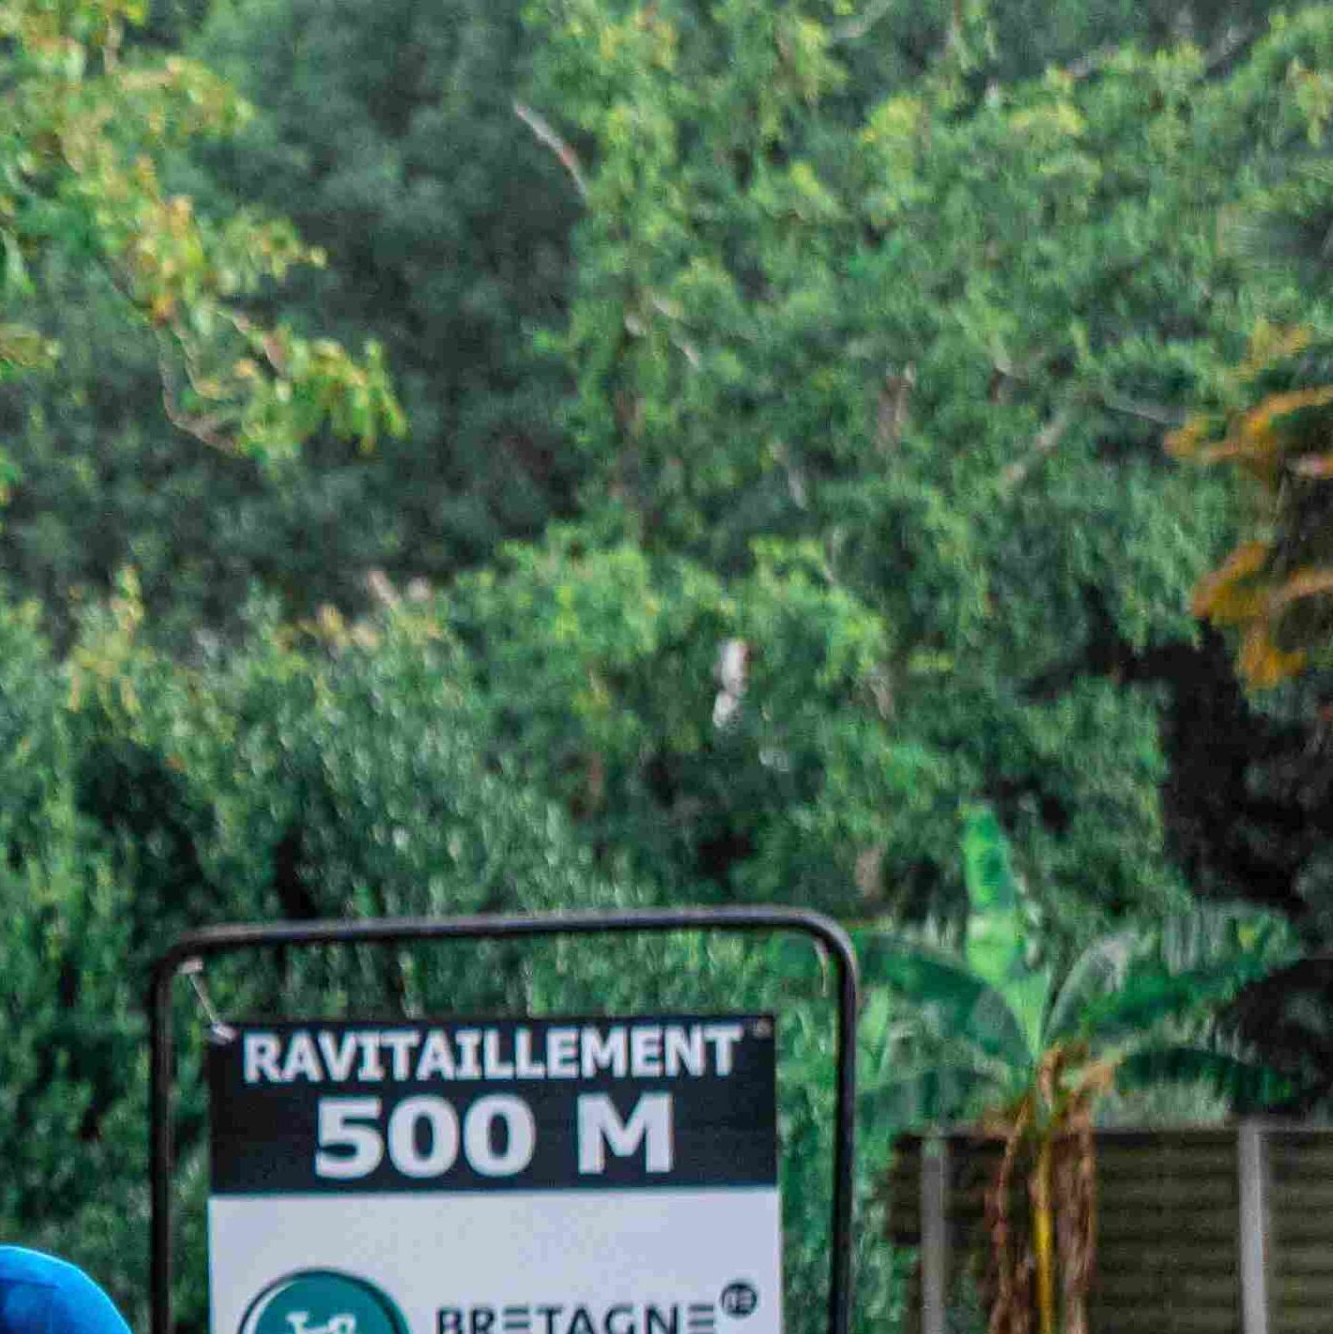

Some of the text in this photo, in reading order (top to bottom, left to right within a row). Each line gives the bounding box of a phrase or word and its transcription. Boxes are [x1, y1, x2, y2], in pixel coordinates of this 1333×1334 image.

[243, 1025, 742, 1083] RAVITAILLEMENT
[315, 1092, 674, 1180] 500 M
